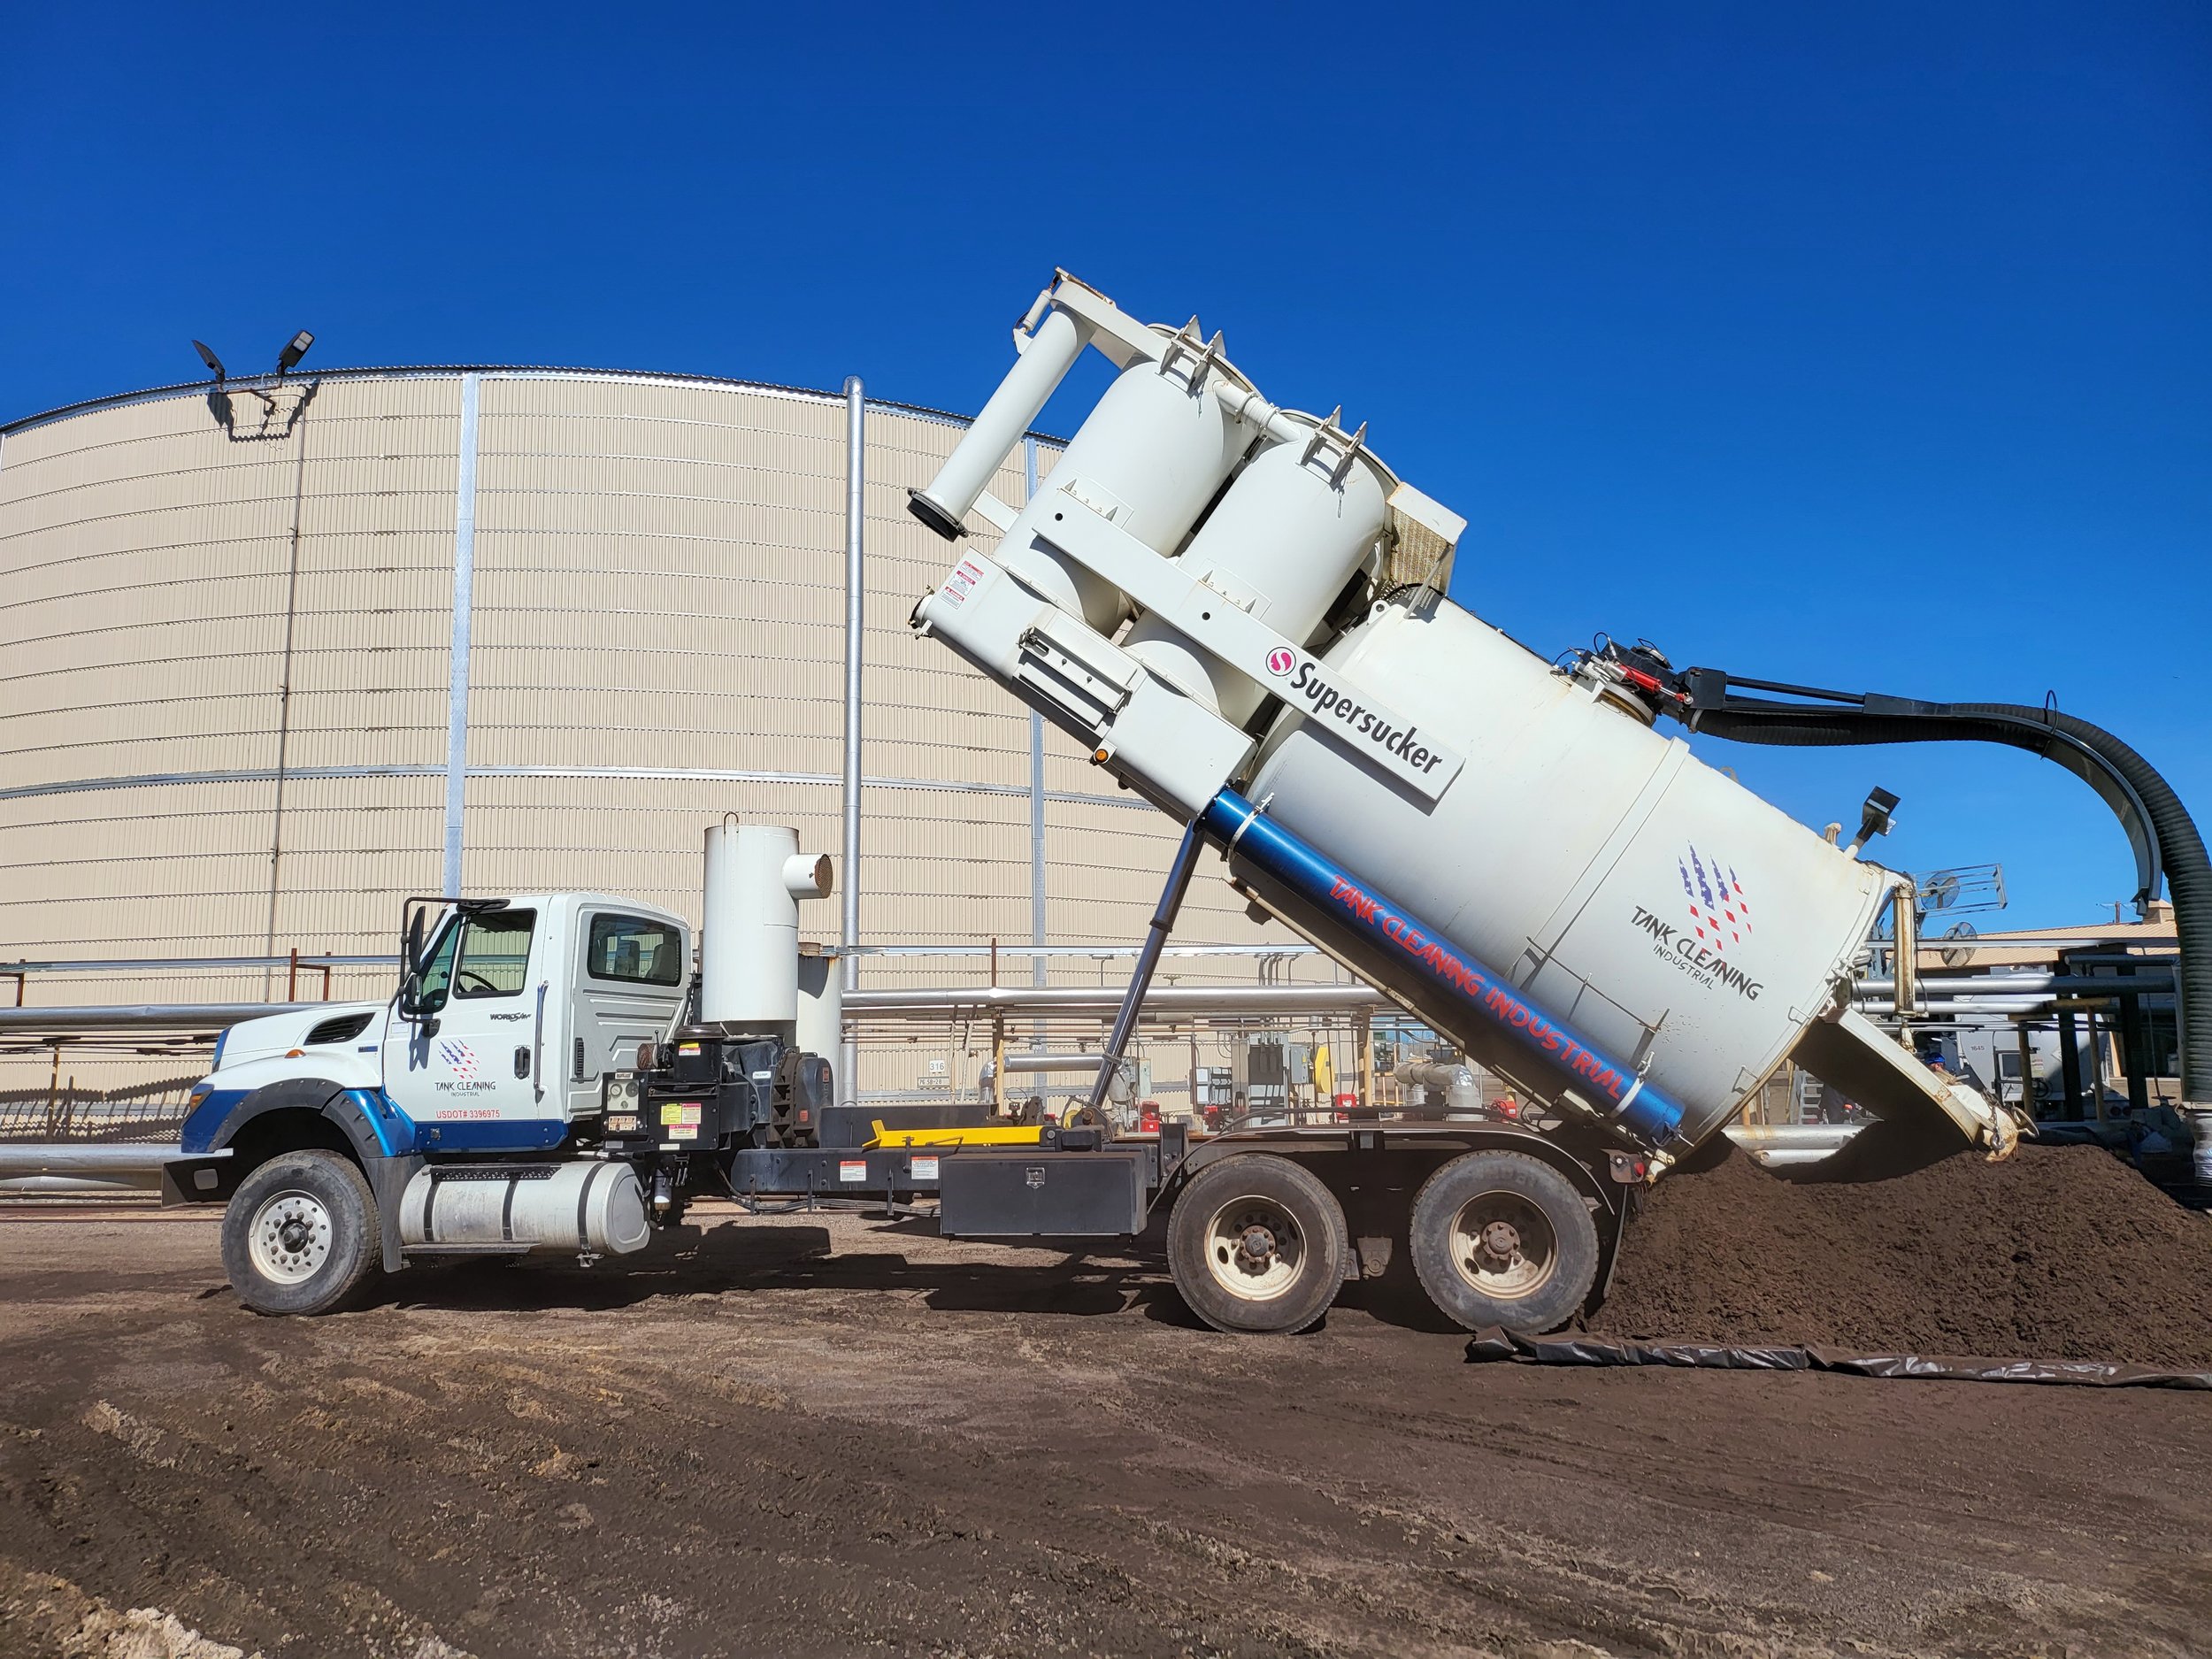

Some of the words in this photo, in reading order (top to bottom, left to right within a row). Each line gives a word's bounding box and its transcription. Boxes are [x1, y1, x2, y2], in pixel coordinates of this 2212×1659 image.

[1290, 662, 1443, 774] Supersucker
[1329, 875, 1386, 926] TANK
[1381, 916, 1487, 997] CLEANING
[1485, 986, 1624, 1101] INDUSTRIAL
[1630, 905, 1678, 946] TANK
[1676, 938, 1764, 1002] CLEANING
[1653, 943, 1713, 990] INDUSTRIAL
[434, 1081, 455, 1092] TANK
[457, 1080, 496, 1092] CLEANING
[435, 1110, 468, 1119] USDOT#
[469, 1109, 501, 1118] 3396975
